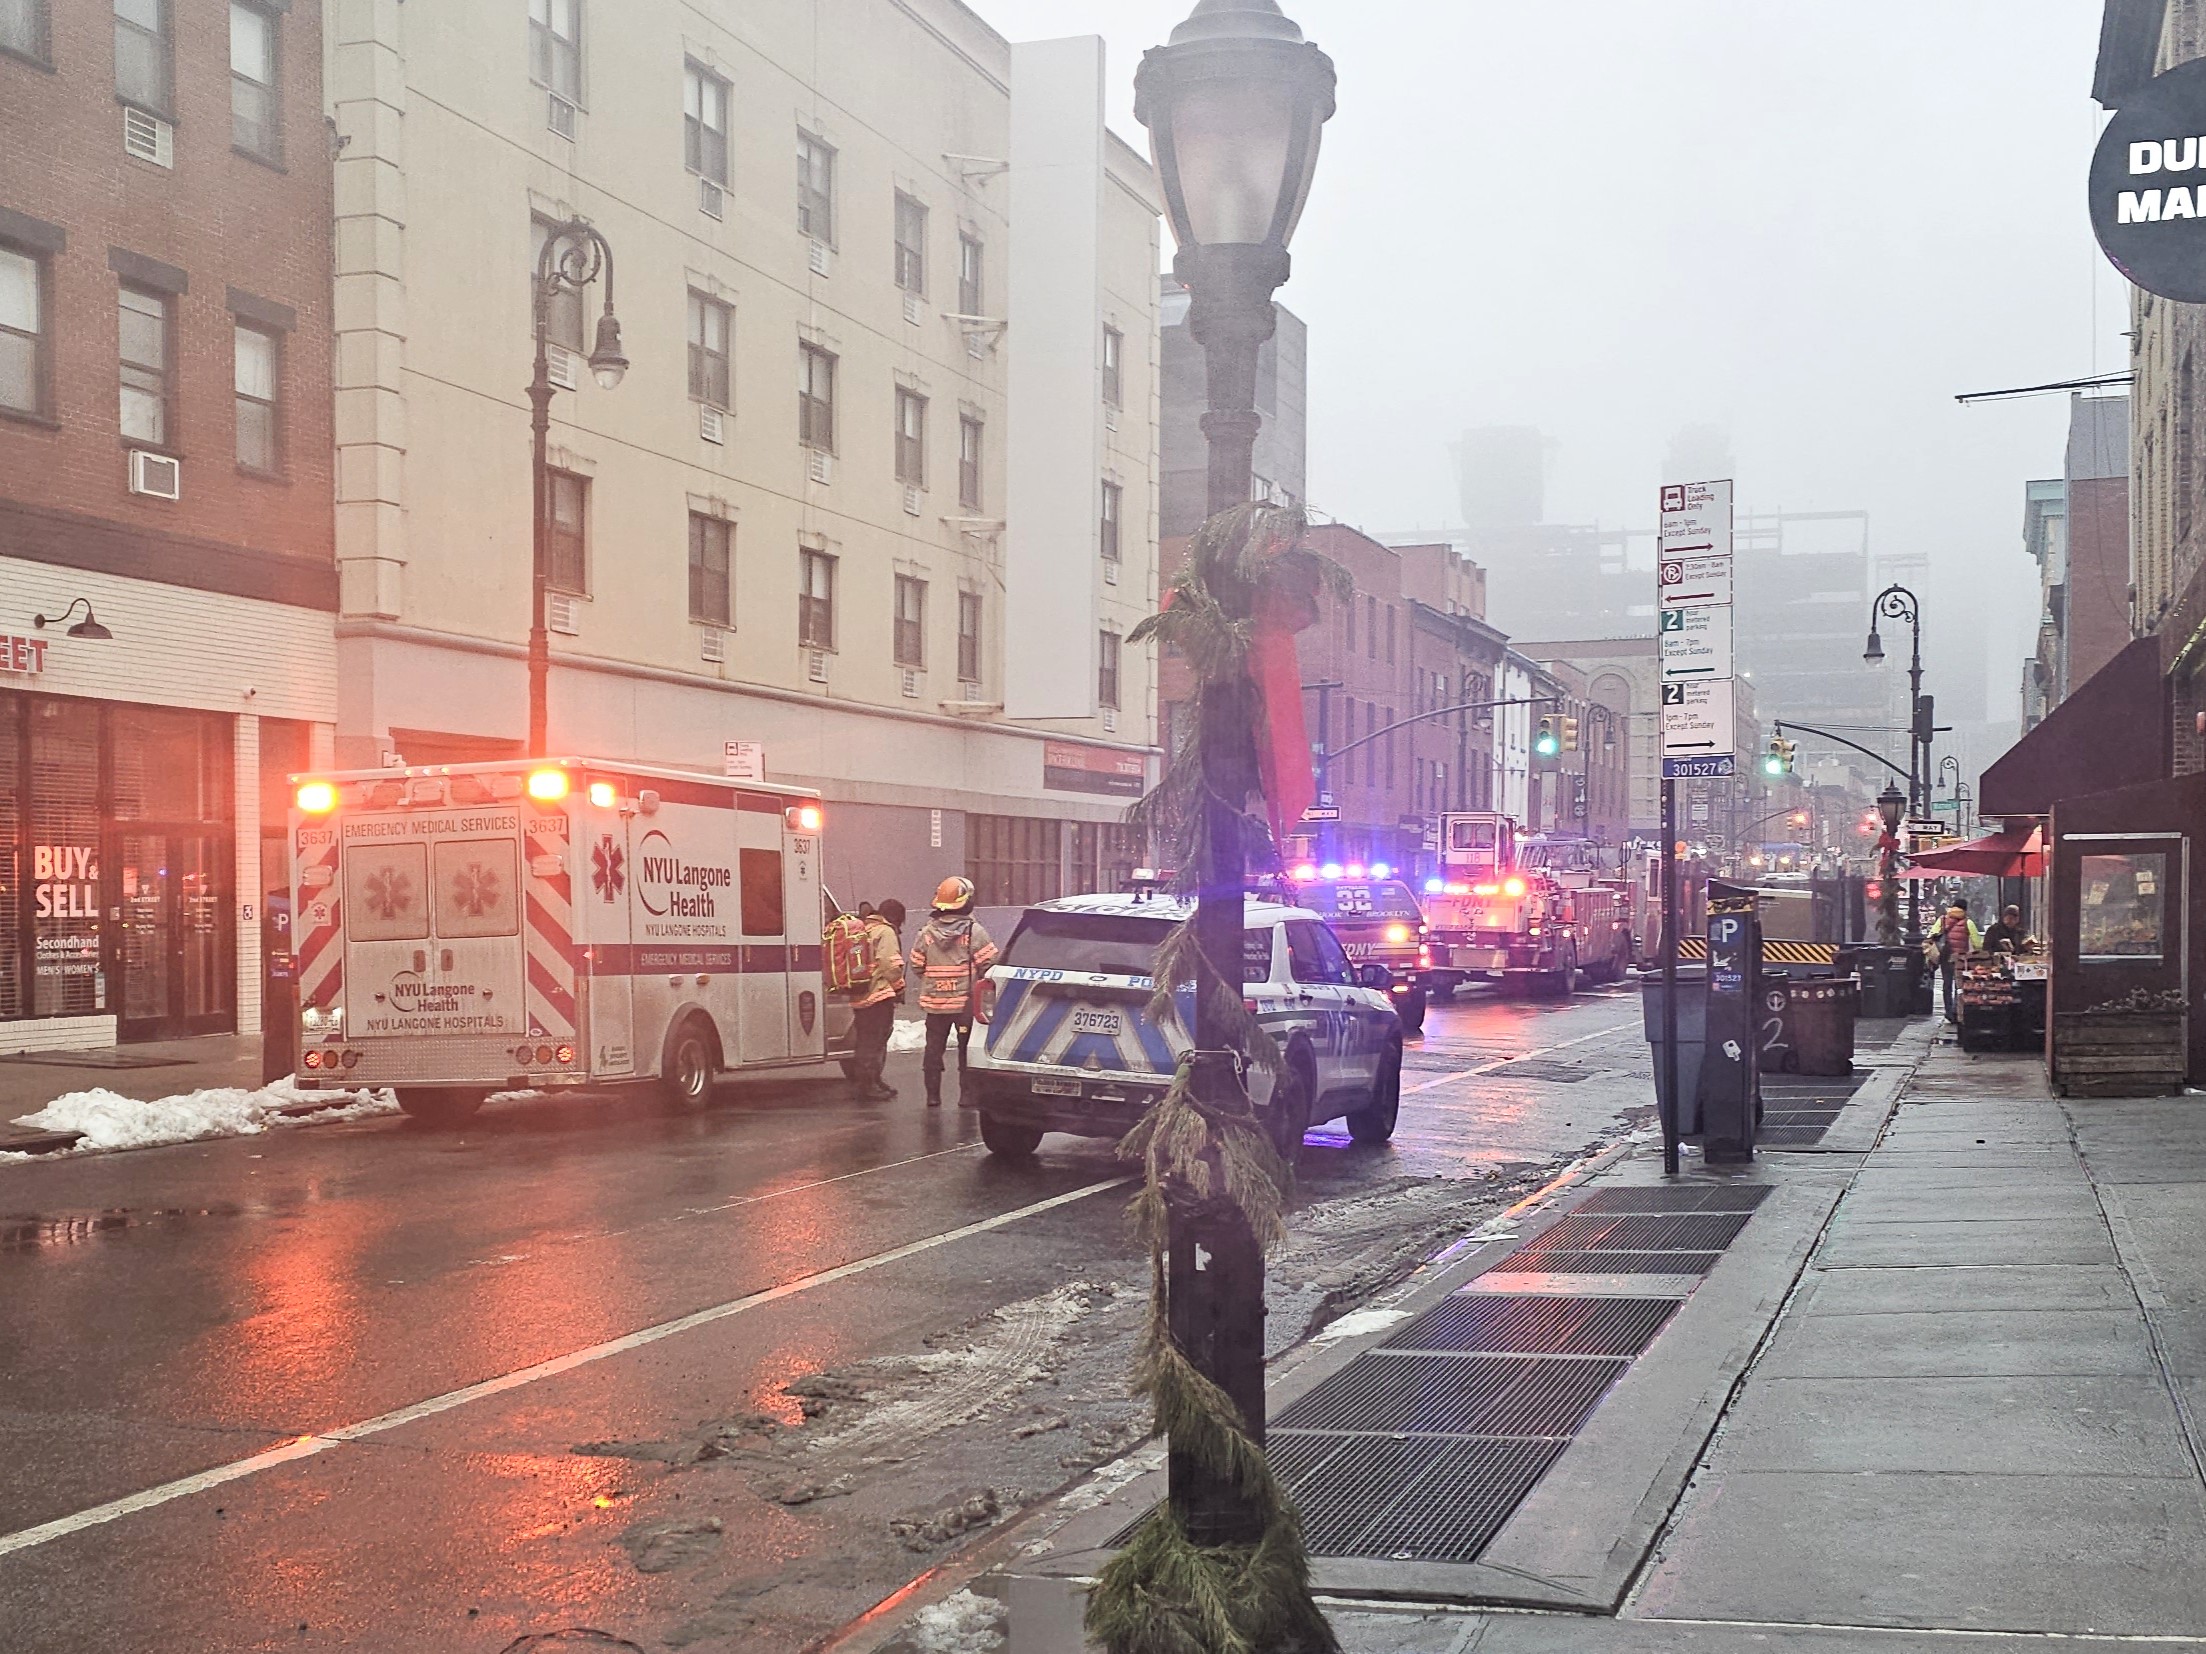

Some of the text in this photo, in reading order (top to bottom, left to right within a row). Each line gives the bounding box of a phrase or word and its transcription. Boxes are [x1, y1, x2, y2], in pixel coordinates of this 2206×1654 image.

[2129, 135, 2206, 175] DU
[2118, 184, 2206, 224] MA
[1687, 486, 1706, 494] Truck
[1687, 493, 1714, 502] Loading
[1687, 502, 1703, 511] Only
[1664, 526, 1712, 538] Except Sunday
[1666, 610, 1678, 630] 2
[1664, 647, 1714, 657] Except Sunday
[1667, 684, 1680, 704] 2
[1666, 722, 1714, 730] Except Sunday
[1673, 762, 1716, 776] 301527
[345, 816, 516, 838] EMERGENCY MEDICAL SERVICES
[529, 818, 565, 834] 3637
[301, 830, 334, 846] 3637
[794, 838, 811, 854] 3637
[34, 846, 92, 880] BUY
[644, 856, 731, 892] NYU Langone
[36, 884, 99, 918] SELL
[670, 891, 715, 918] Health
[646, 924, 726, 938] NYU LANGONE HOSPITALS
[1721, 918, 1738, 942] P
[36, 934, 100, 950] Secondhand
[641, 952, 732, 966] EMERGENCY MEDICAL SERVICES
[1013, 968, 1064, 982] NYPD
[394, 983, 476, 999] NYU Langone
[417, 998, 459, 1012] Health
[368, 1016, 504, 1031] NYU LANGONE HOSPITALS
[1074, 1012, 1120, 1030] 376723
[1762, 1017, 1789, 1051] 2
